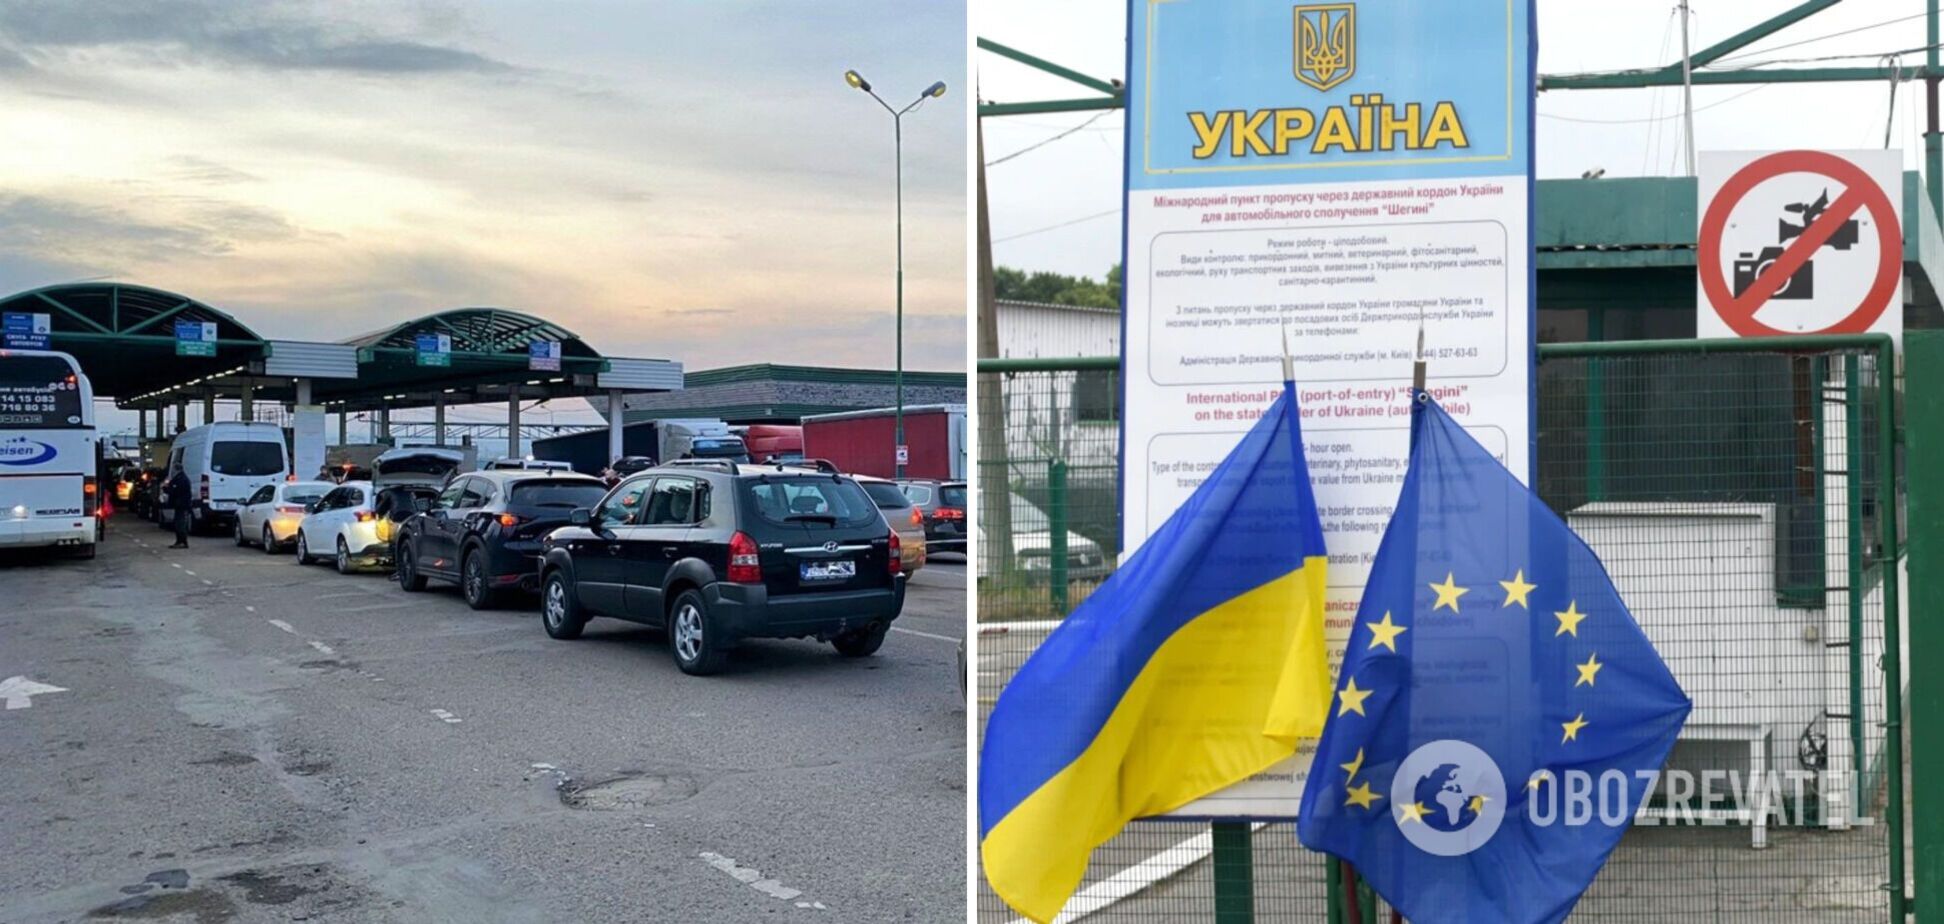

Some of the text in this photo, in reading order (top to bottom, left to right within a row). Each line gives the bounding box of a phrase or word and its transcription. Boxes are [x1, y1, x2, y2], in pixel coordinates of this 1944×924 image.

[1186, 93, 1469, 160] УКРАЇНА
[1154, 184, 1504, 208] Міжнародний пункт пропуску через державний кордон України
[1201, 212, 1222, 224] для
[1224, 208, 1312, 222] автомобільного
[1314, 206, 1378, 220] сполучення
[1268, 239, 1294, 248] Режим
[1296, 238, 1326, 249] роботи
[1180, 254, 1202, 265] Види
[1376, 260, 1408, 272] України
[1214, 304, 1251, 315] пропуску
[1280, 302, 1324, 313] державний
[1326, 302, 1357, 311] кордон
[1359, 300, 1391, 310] України
[1440, 297, 1472, 306] України
[1474, 298, 1484, 306] та
[1294, 316, 1340, 325] посадових
[1342, 312, 1360, 322] осіб
[1462, 308, 1494, 318] України
[1294, 328, 1303, 336] за
[1344, 350, 1375, 361] служби
[1186, 391, 1267, 404] International
[1300, 387, 1396, 403] (port-of-entry)
[1194, 411, 1211, 421] on
[1214, 409, 1235, 420] the
[1318, 406, 1332, 418] of
[1334, 404, 1385, 417] Ukraine
[1310, 443, 1353, 454] hour open.
[1152, 461, 1170, 475] Type
[1172, 460, 1181, 472] of
[1182, 460, 1194, 472] the
[1344, 456, 1400, 473] phytosanitary,
[1318, 472, 1340, 483] value
[1342, 472, 1361, 484] from
[1362, 470, 1394, 484] Ukraine
[1328, 504, 1355, 517] border
[1342, 519, 1379, 534] following
